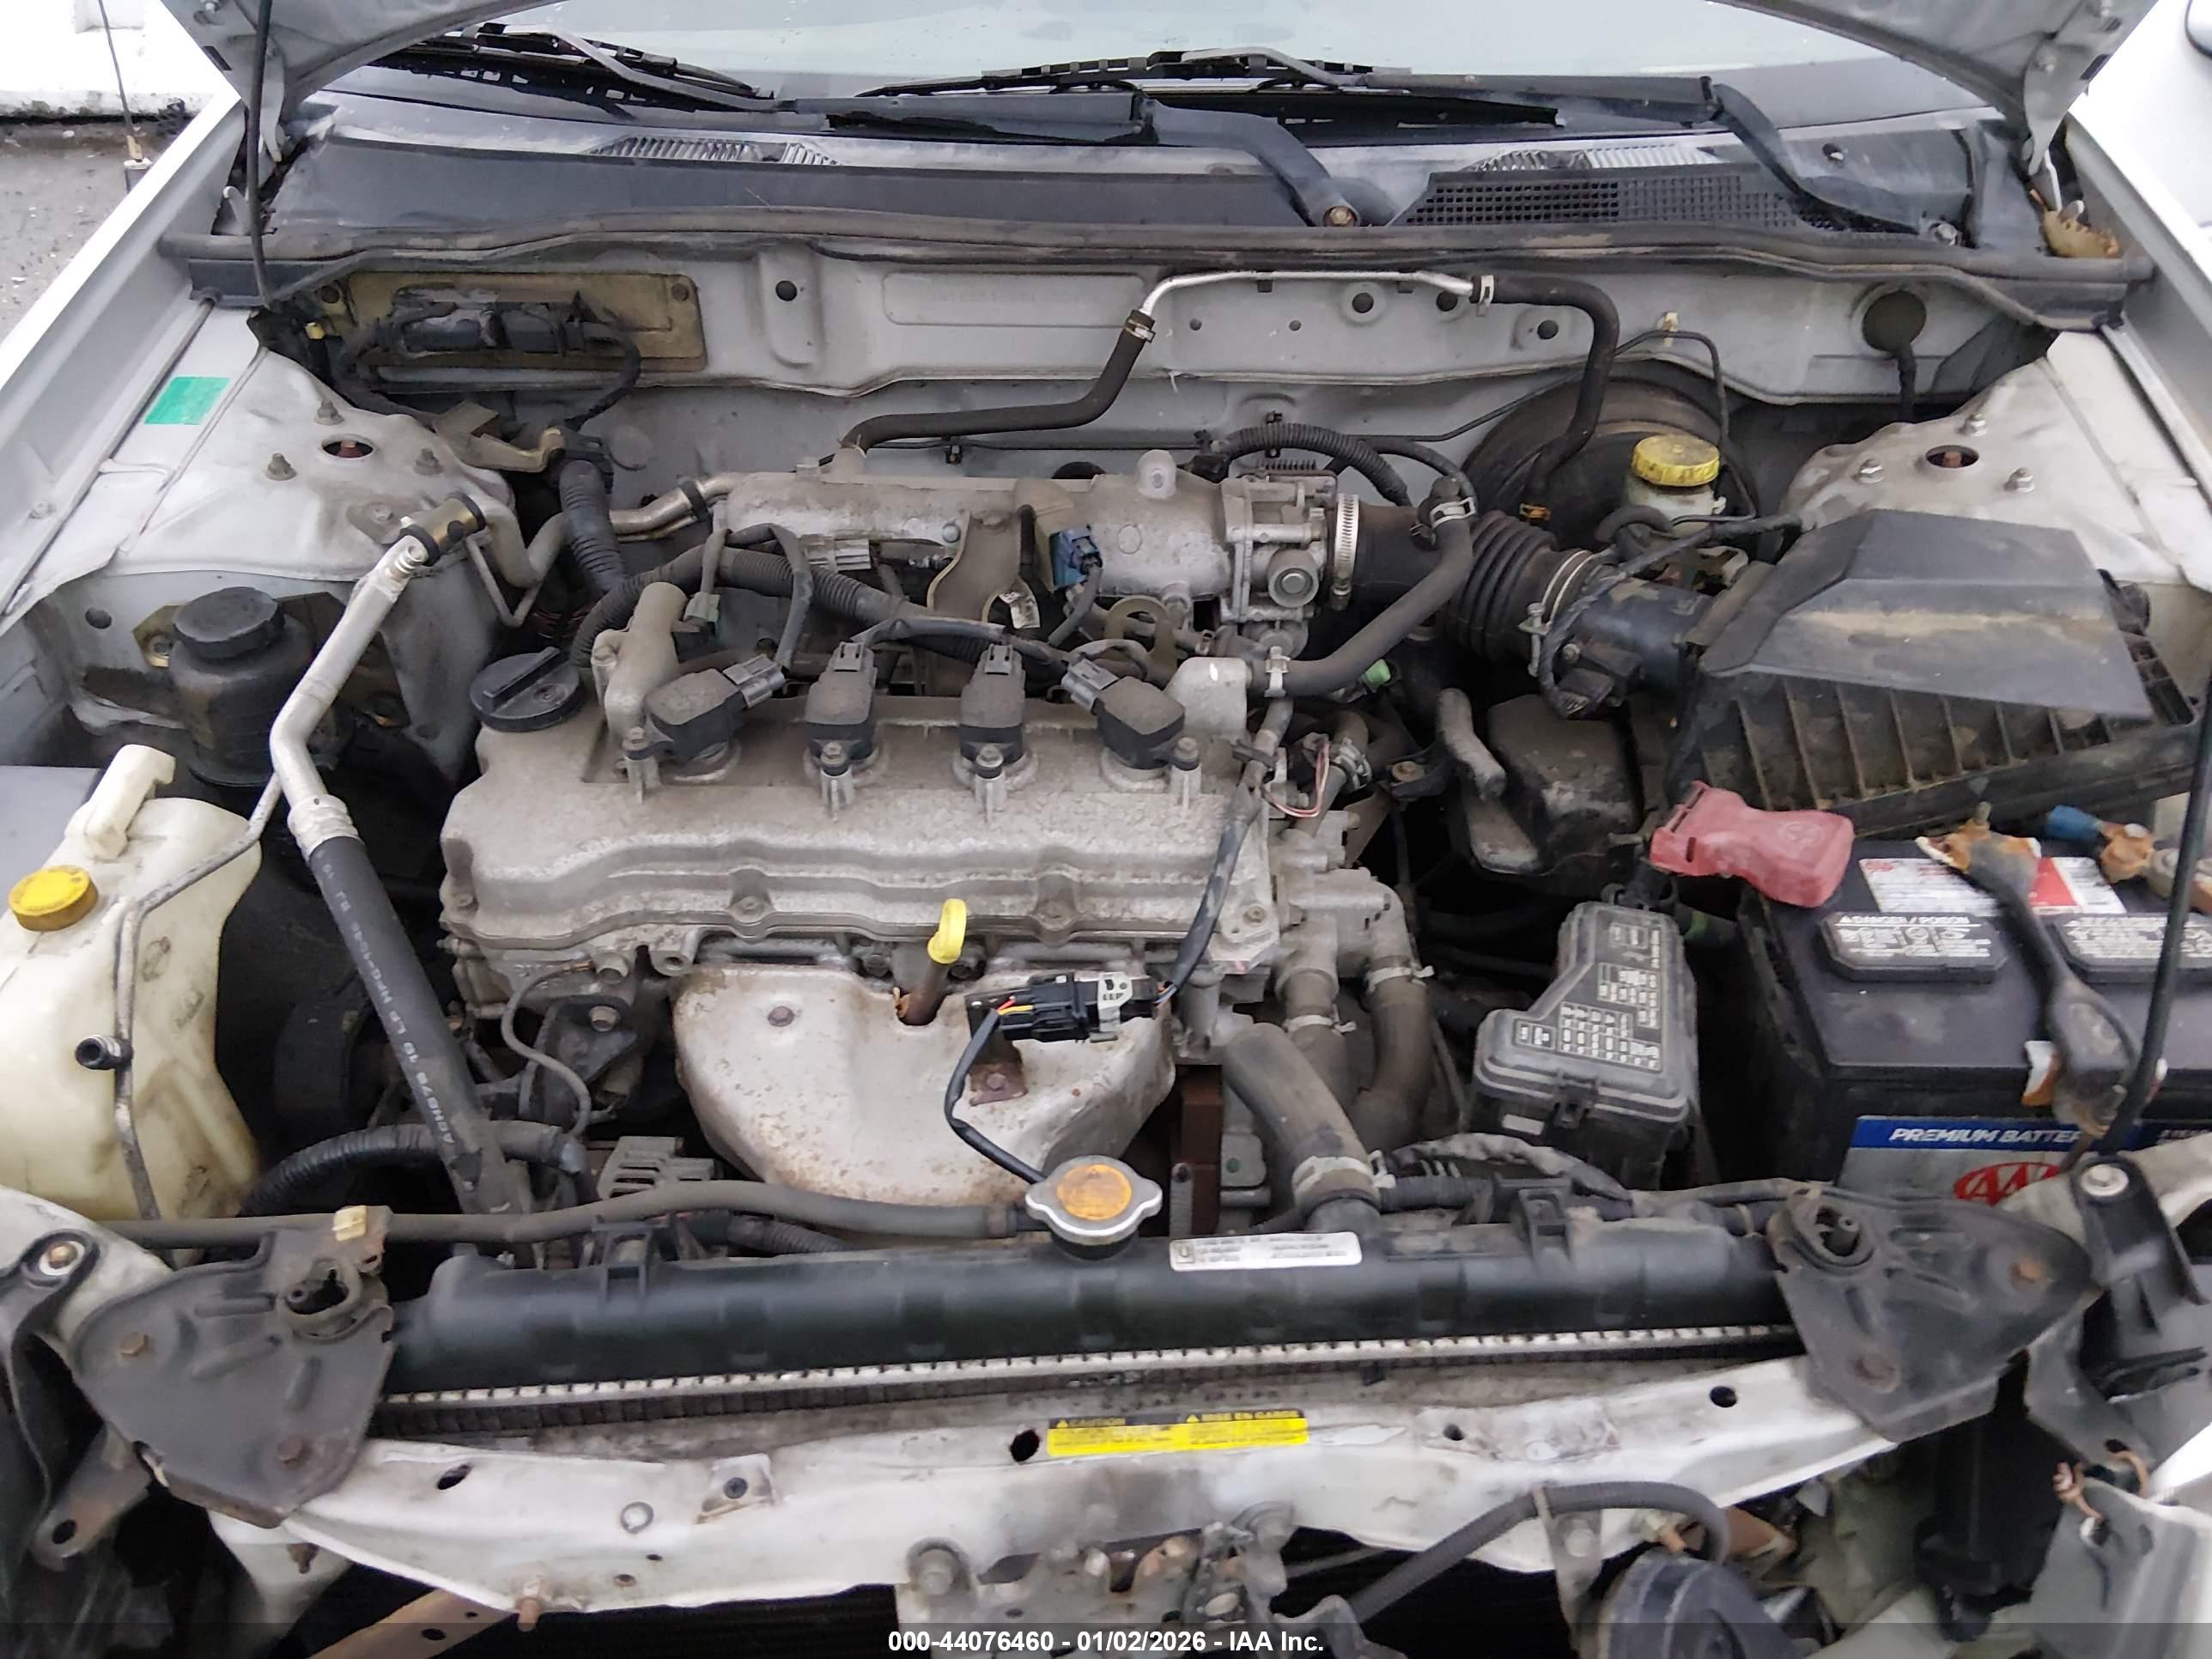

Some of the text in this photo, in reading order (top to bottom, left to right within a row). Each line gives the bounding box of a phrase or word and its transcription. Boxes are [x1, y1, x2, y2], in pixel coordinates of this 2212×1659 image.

[1889, 1128, 2081, 1143] PREMIUM BATTER
[1954, 1163, 2059, 1207] AA
